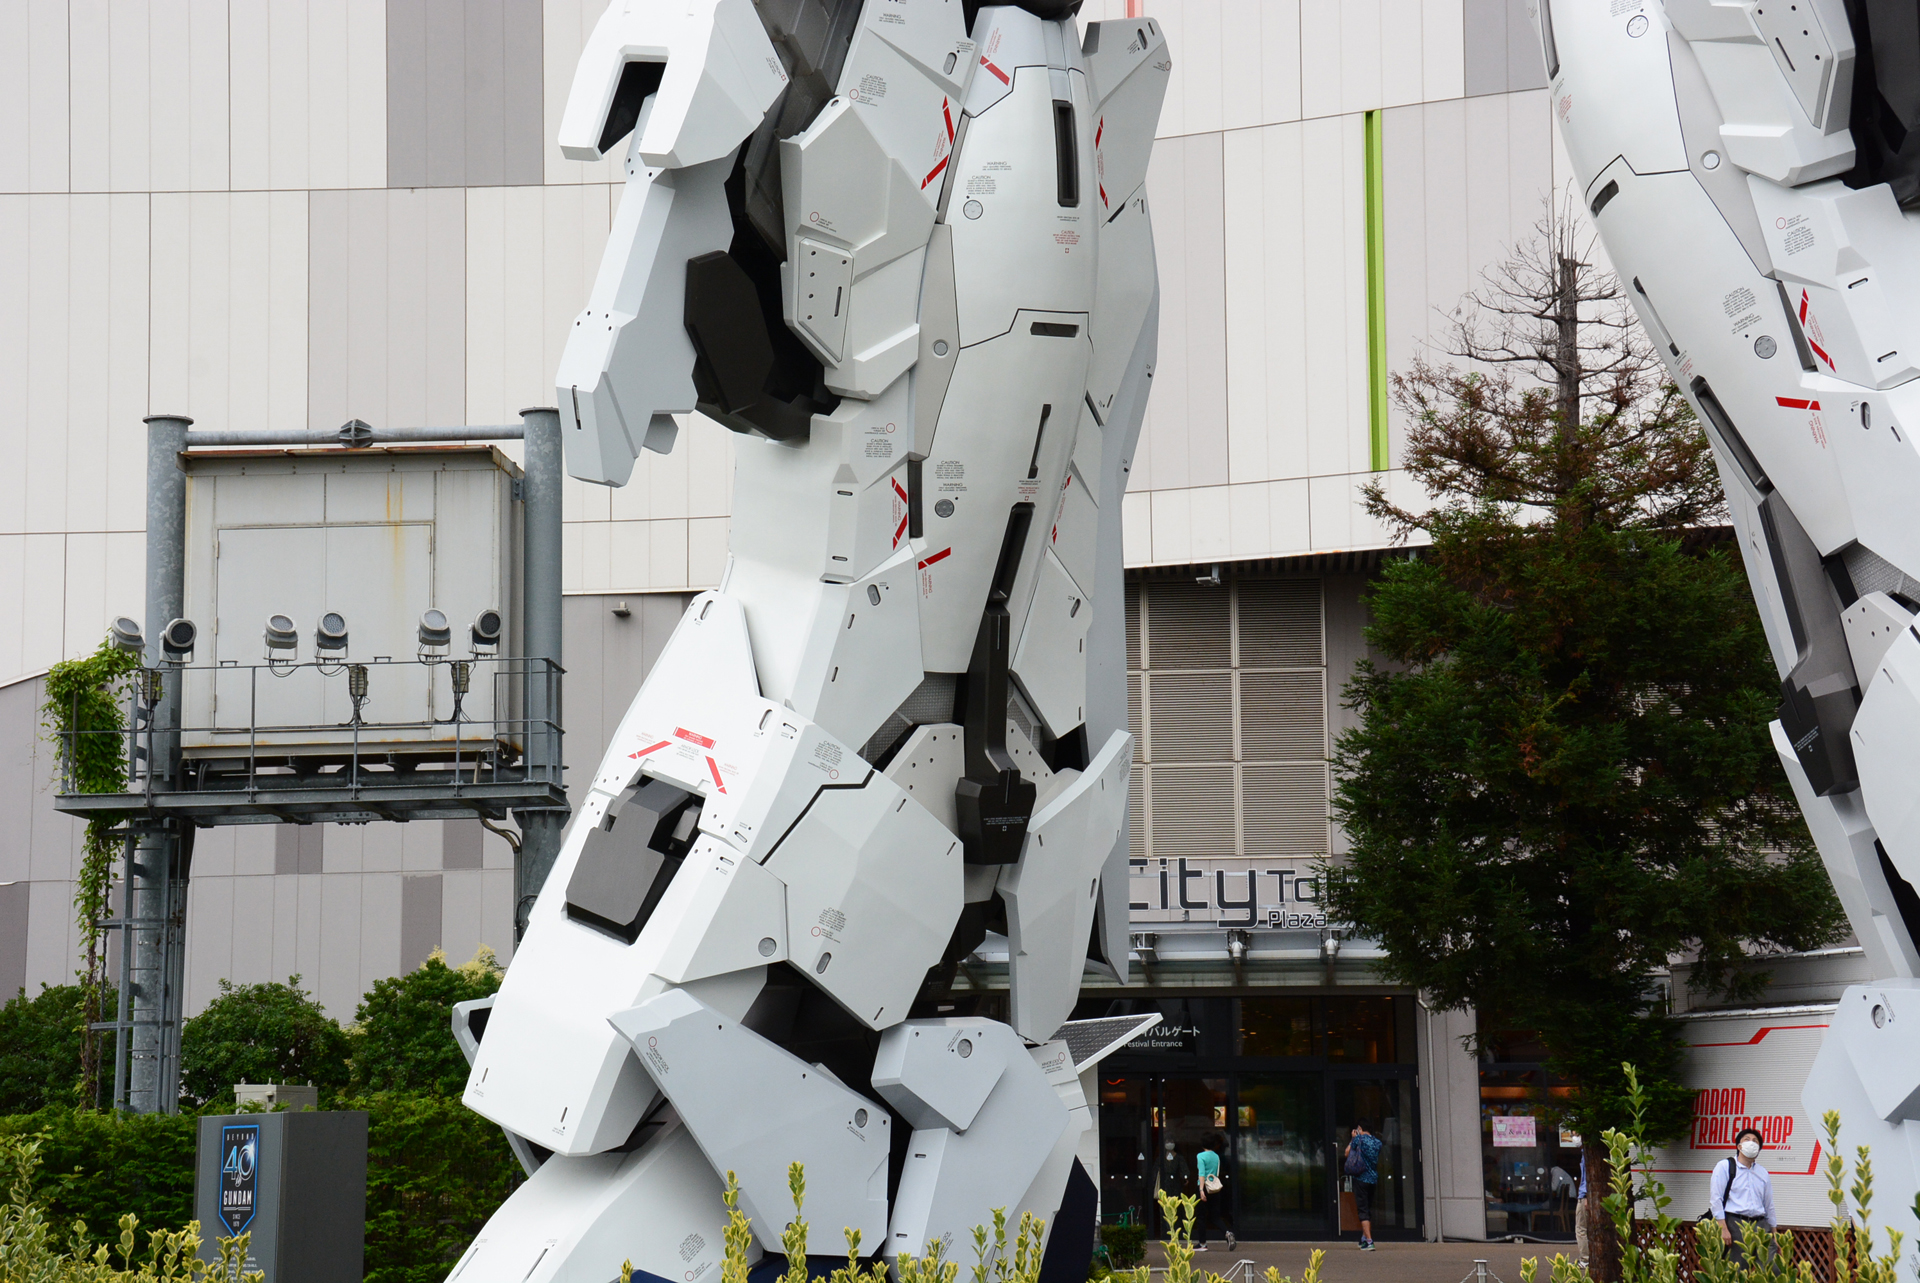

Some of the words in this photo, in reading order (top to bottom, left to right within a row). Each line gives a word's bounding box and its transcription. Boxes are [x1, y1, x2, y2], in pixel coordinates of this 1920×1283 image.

[1787, 226, 1806, 237] CAUTION
[1725, 286, 1745, 300] CAUTION
[1733, 313, 1755, 327] WARNING
[823, 740, 841, 750] CAUTION
[828, 907, 845, 917] CAUTION
[1267, 909, 1327, 929] Plaza
[1151, 1039, 1183, 1048] Entrance
[226, 1133, 254, 1141] BEYOND
[223, 1190, 252, 1206] GUNDAM
